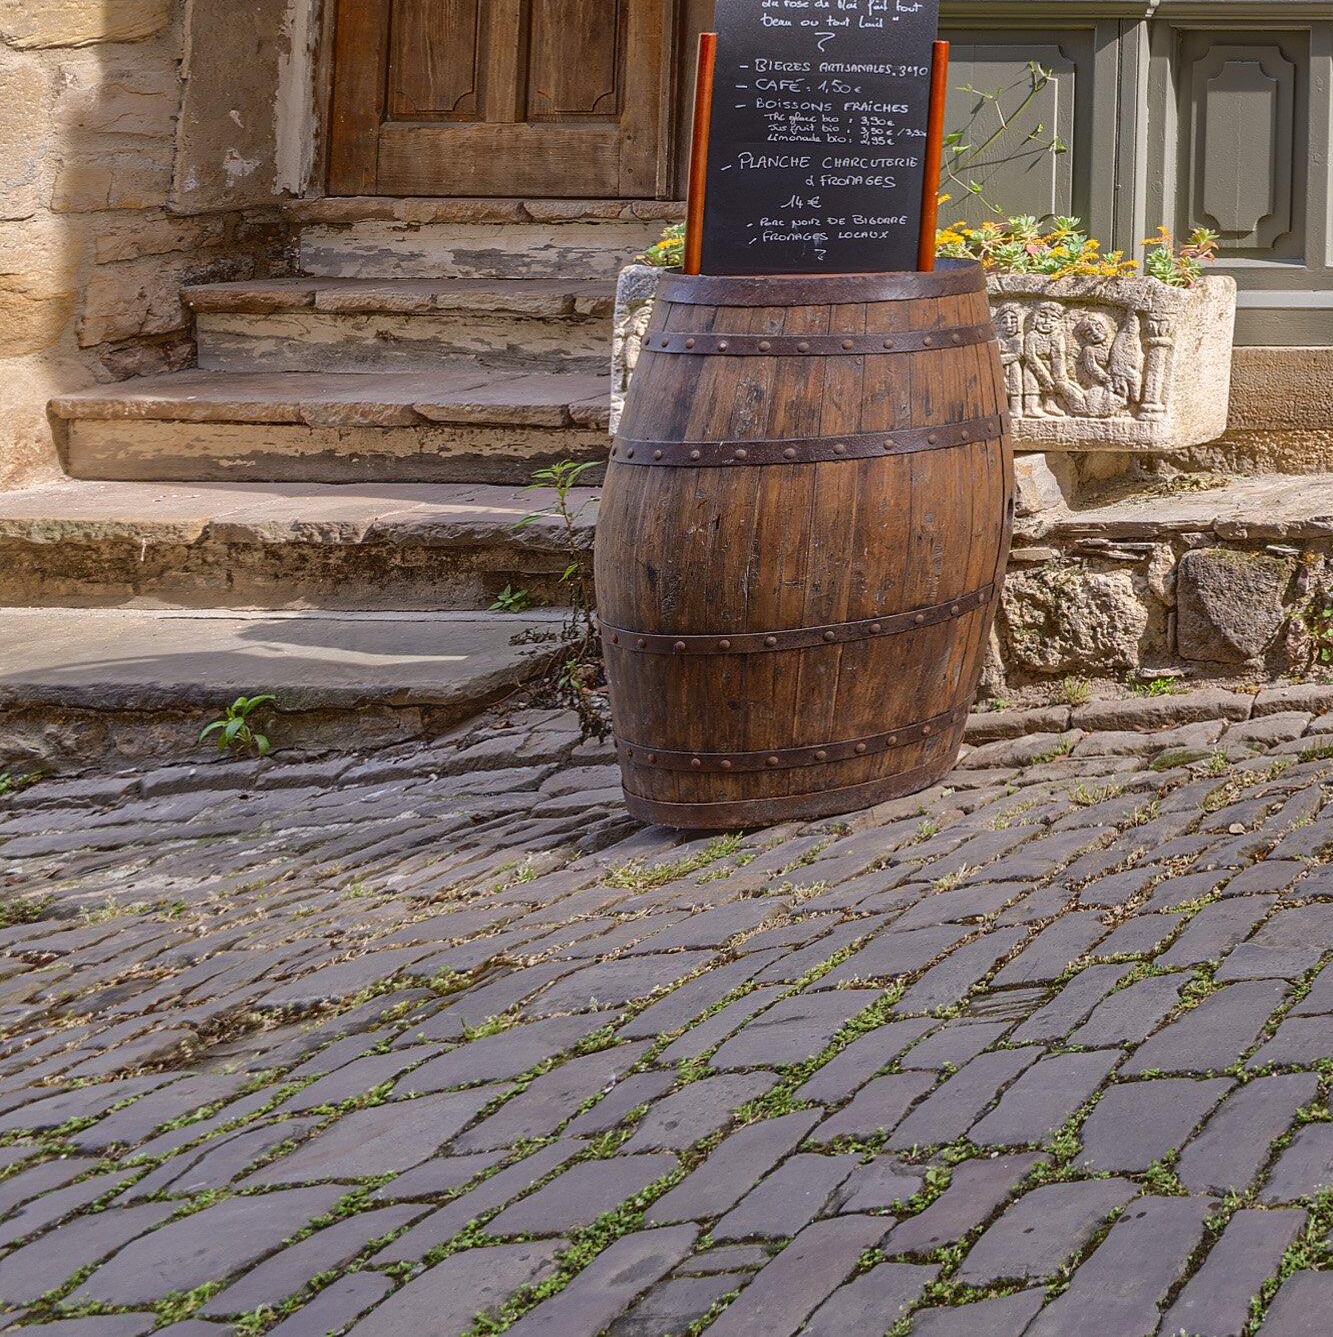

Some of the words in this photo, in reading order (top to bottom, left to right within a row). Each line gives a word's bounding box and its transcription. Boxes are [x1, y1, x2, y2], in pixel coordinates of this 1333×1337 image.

[800, 18, 819, 27] ou
[826, 16, 850, 27] tout
[755, 58, 811, 73] BIERES
[822, 114, 839, 123] bio
[822, 124, 840, 133] bio
[738, 151, 811, 170] PLANCHE
[822, 157, 918, 168] CHARCUTERIE
[820, 175, 896, 188] FROMAGES
[826, 217, 846, 226] DE
[852, 214, 908, 226] BIGORRE
[762, 230, 829, 242] FROMAGES
[838, 230, 889, 240] LOCAUX
